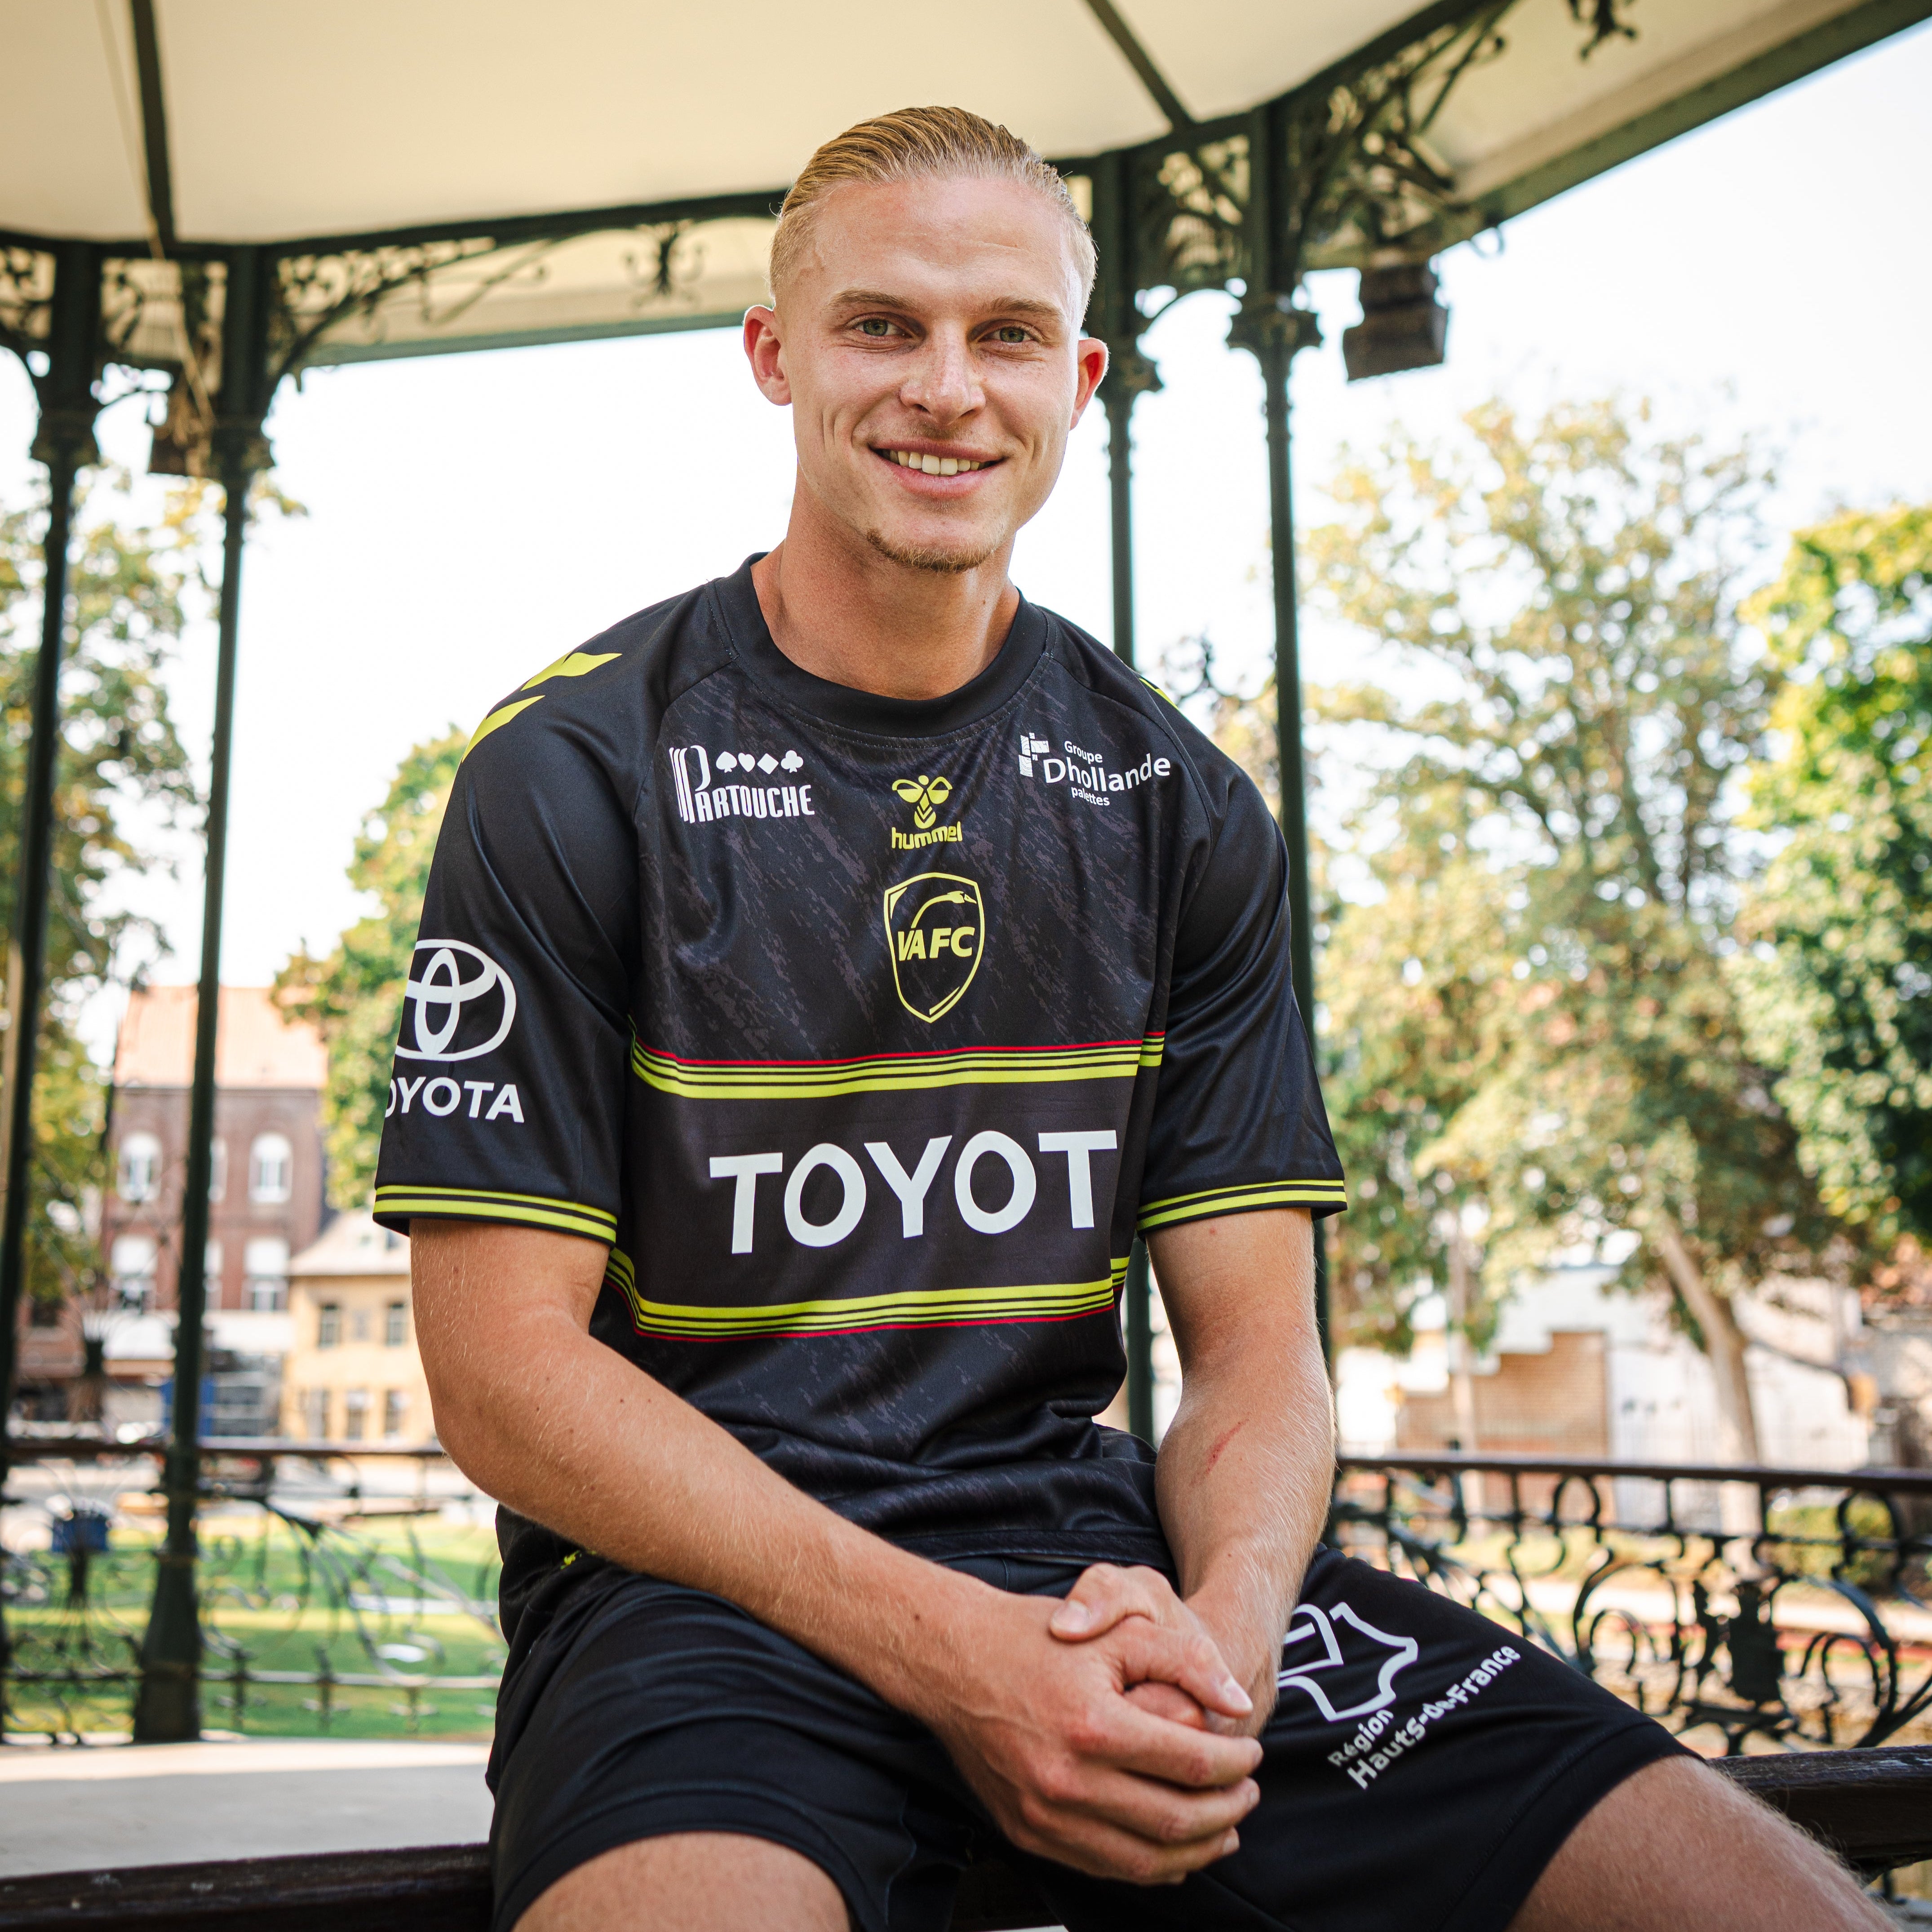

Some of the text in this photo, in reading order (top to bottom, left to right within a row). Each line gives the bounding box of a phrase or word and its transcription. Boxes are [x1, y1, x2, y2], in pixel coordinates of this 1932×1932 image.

[1064, 740, 1103, 765] Groupe
[1043, 753, 1171, 792] Dhollande
[1071, 787, 1110, 806] palettes
[891, 821, 963, 850] hummel
[1347, 1645, 1522, 1790] Hauts-de-France
[1327, 1708, 1394, 1767] Région
